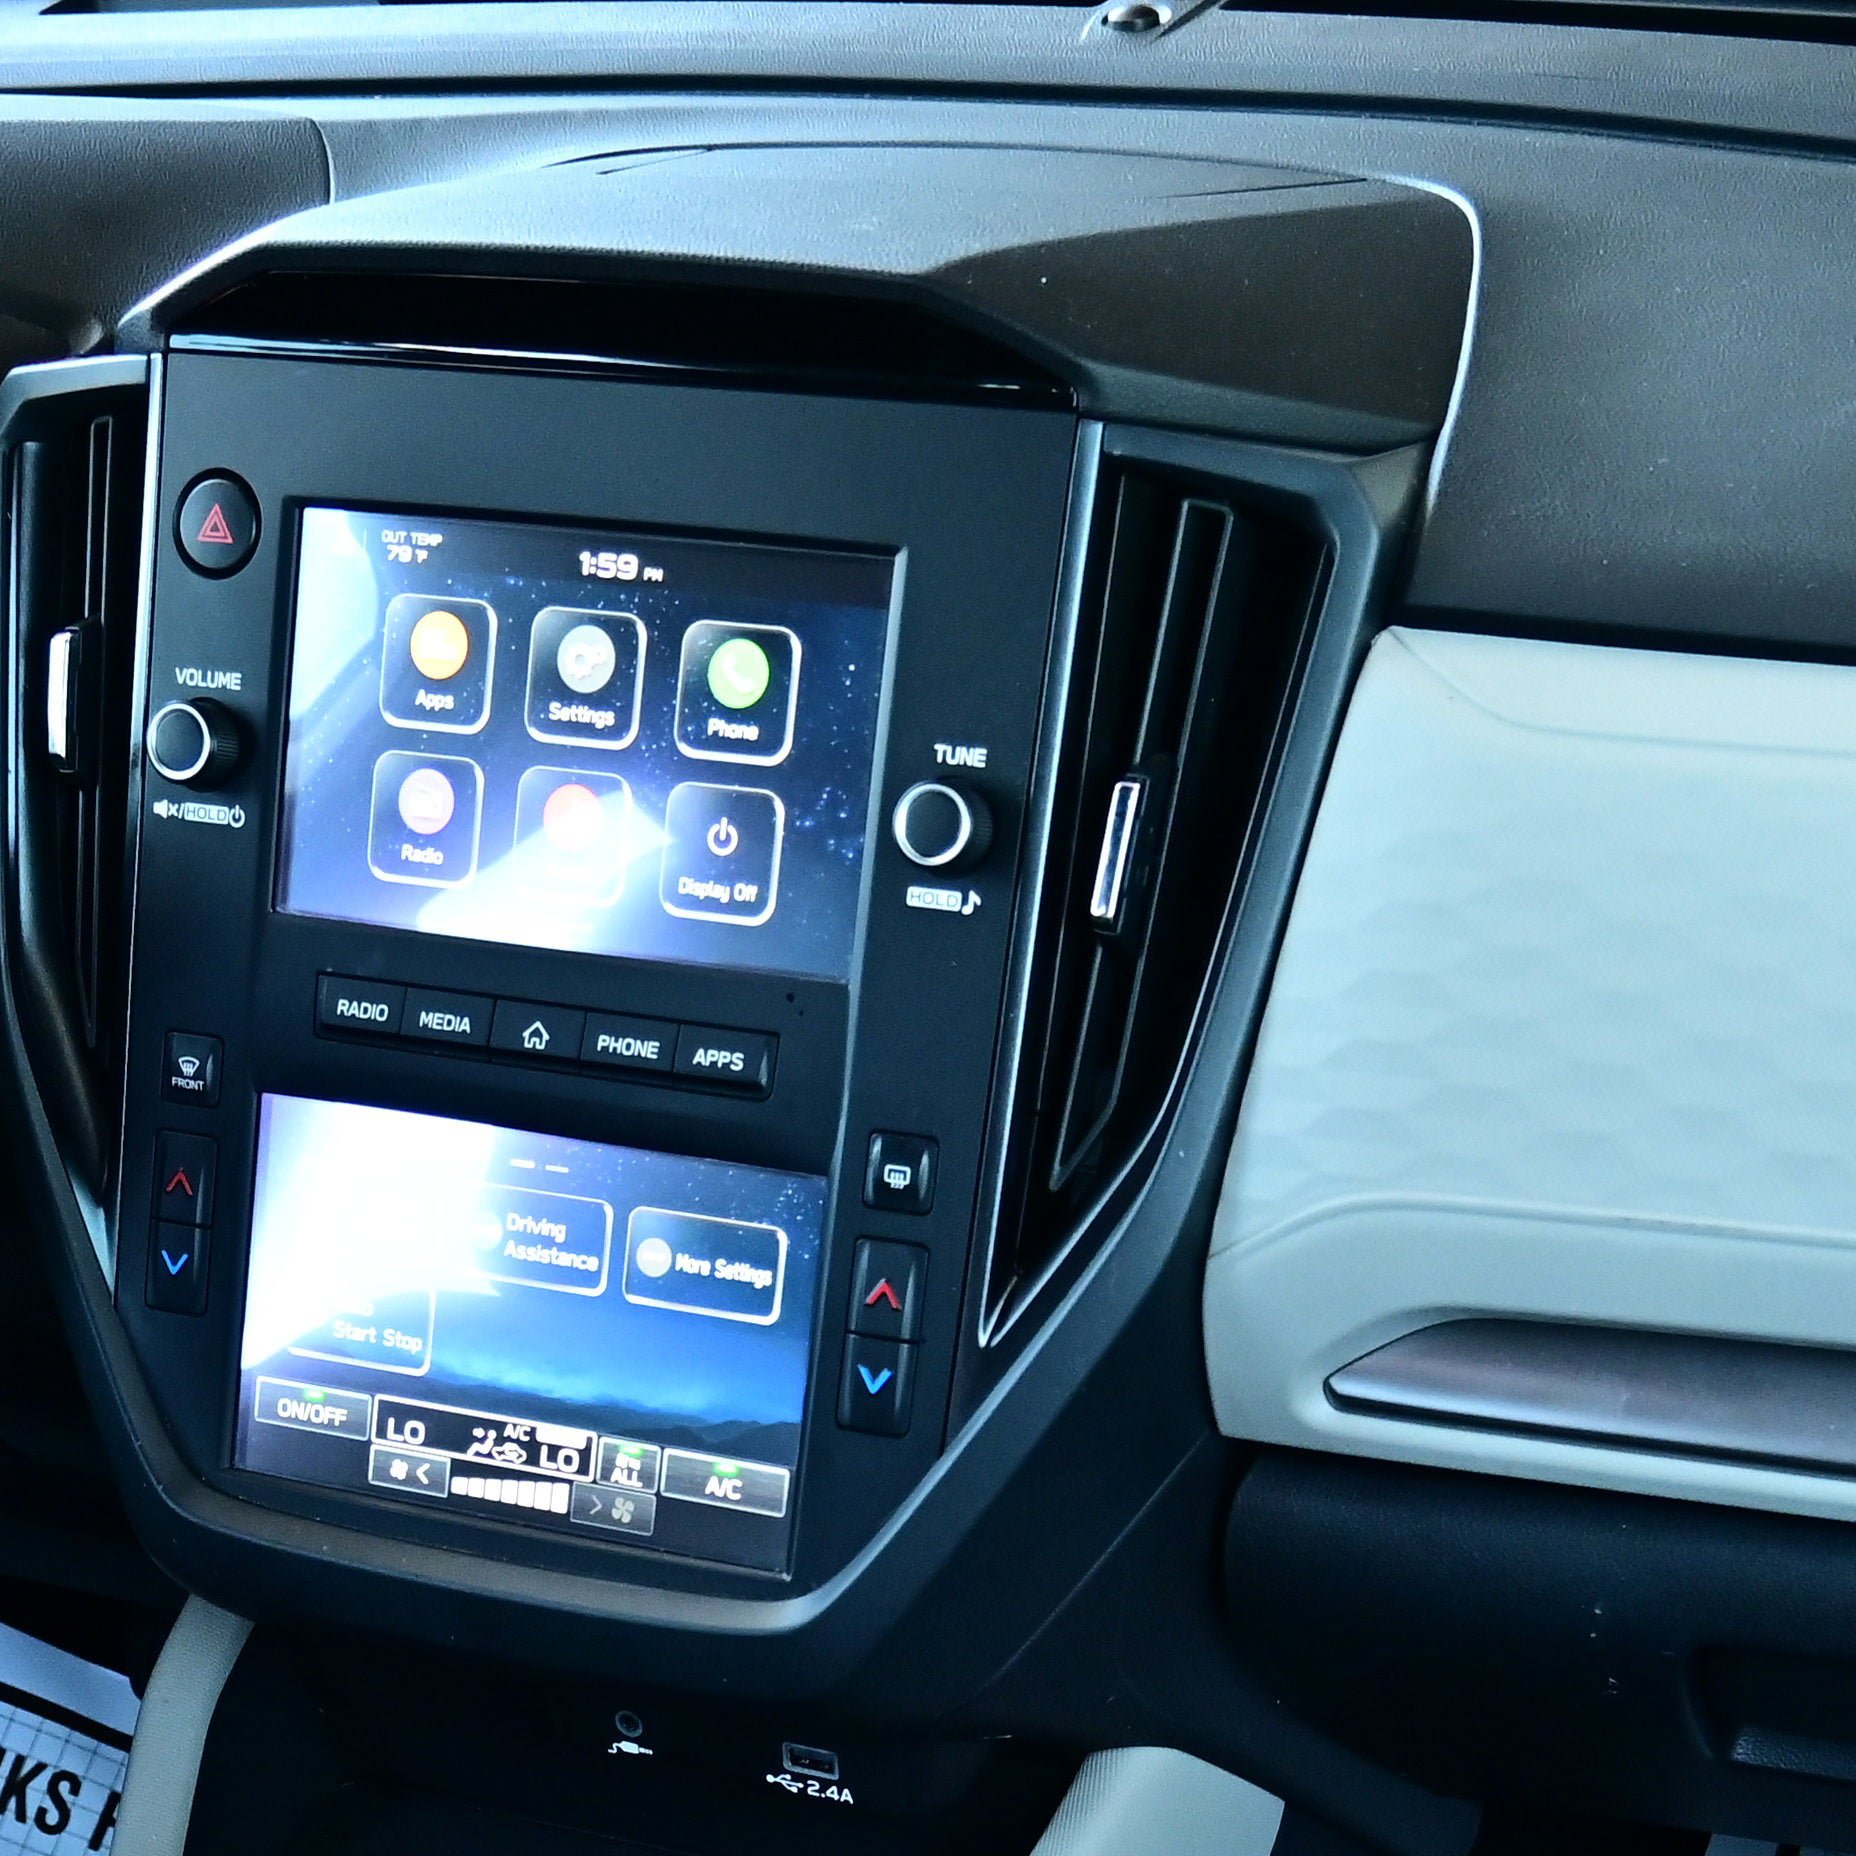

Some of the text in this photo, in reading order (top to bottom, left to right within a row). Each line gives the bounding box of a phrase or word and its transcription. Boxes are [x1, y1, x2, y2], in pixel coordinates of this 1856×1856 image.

[381, 529, 443, 547] OUT TEMP
[579, 550, 664, 582] 1:59 PM
[175, 667, 242, 691] VOLUME
[414, 688, 455, 711] Apps
[548, 702, 615, 729] Settings
[707, 717, 760, 742] Phone
[934, 743, 988, 768] TUNE
[185, 804, 228, 823] HOLD
[401, 843, 444, 866] Radio
[678, 875, 758, 904] Display Off
[909, 890, 959, 909] HOLD
[336, 998, 389, 1023] RADIO
[419, 1010, 471, 1034] MEDIA
[596, 1034, 660, 1060] PHONE
[692, 1048, 744, 1072] APPS
[171, 1076, 205, 1091] FRONT
[506, 1212, 567, 1243] Driving
[503, 1239, 599, 1273] Assistance
[674, 1252, 773, 1289] More Settings
[332, 1320, 423, 1355] Start Stop
[277, 1398, 348, 1427] ON/OFF
[386, 1417, 426, 1445] LO
[503, 1423, 531, 1442] A/C
[540, 1444, 580, 1473] LO
[610, 1469, 643, 1488] ALL
[705, 1475, 743, 1500] A/C
[806, 1780, 854, 1805] 2.4A
